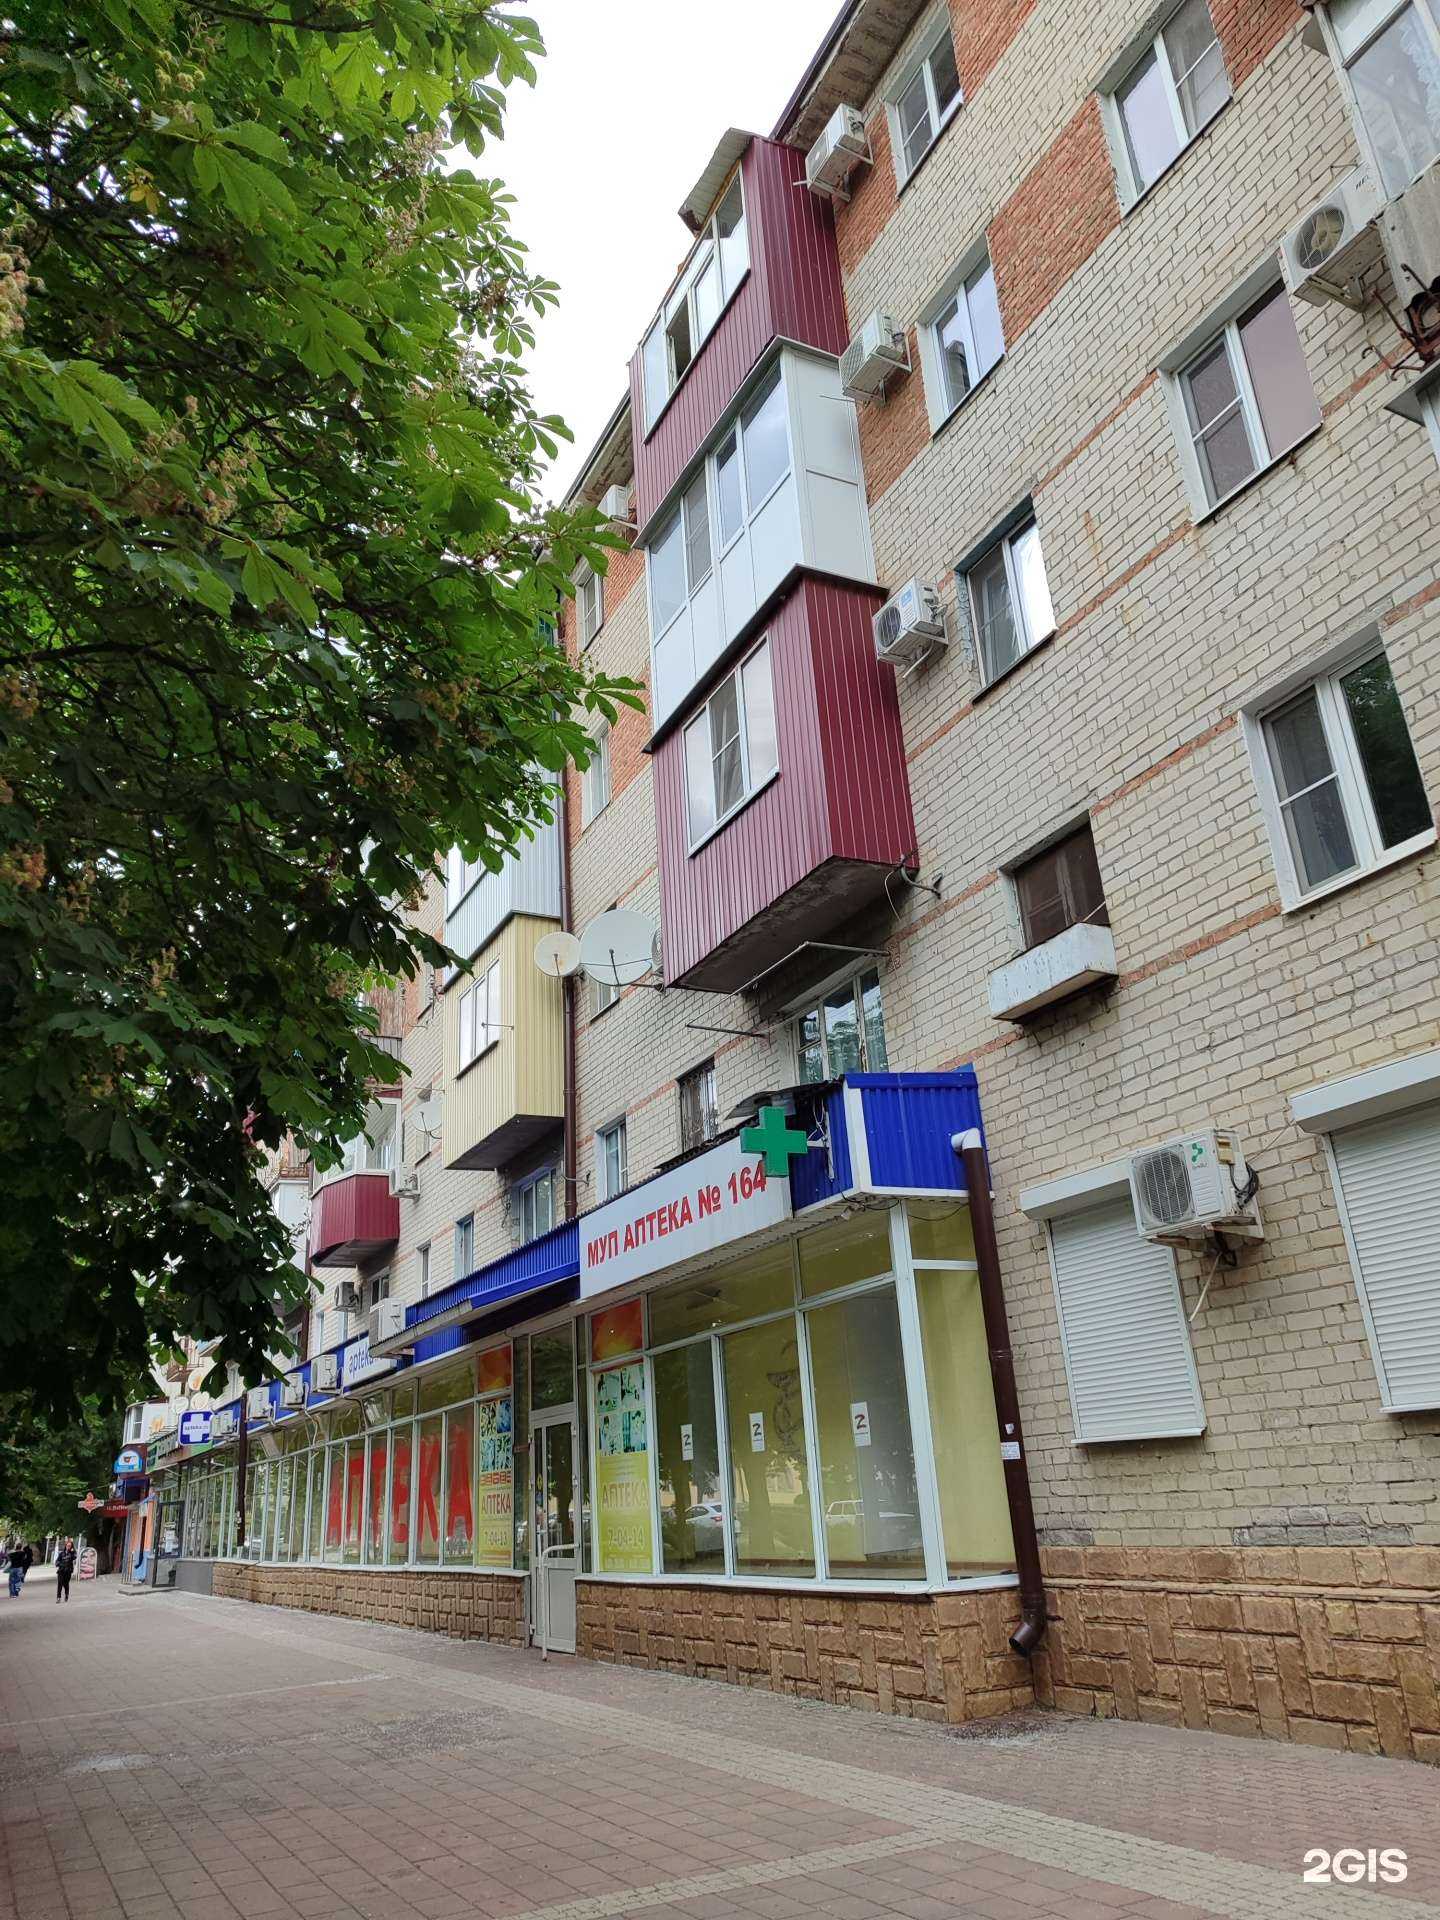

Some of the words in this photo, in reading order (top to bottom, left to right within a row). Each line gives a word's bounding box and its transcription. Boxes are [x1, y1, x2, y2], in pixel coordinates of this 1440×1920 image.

[588, 1230, 618, 1268] МУП
[623, 1196, 693, 1253] АПТЕКА
[697, 1185, 722, 1219] №
[728, 1160, 767, 1204] 164
[752, 1422, 762, 1436] 2
[855, 1414, 867, 1430] 2
[683, 1434, 691, 1446] 2
[326, 1426, 473, 1547] АПТЕКА
[602, 1480, 648, 1508] АПТЕКА
[481, 1493, 512, 1515] АПТЕКА
